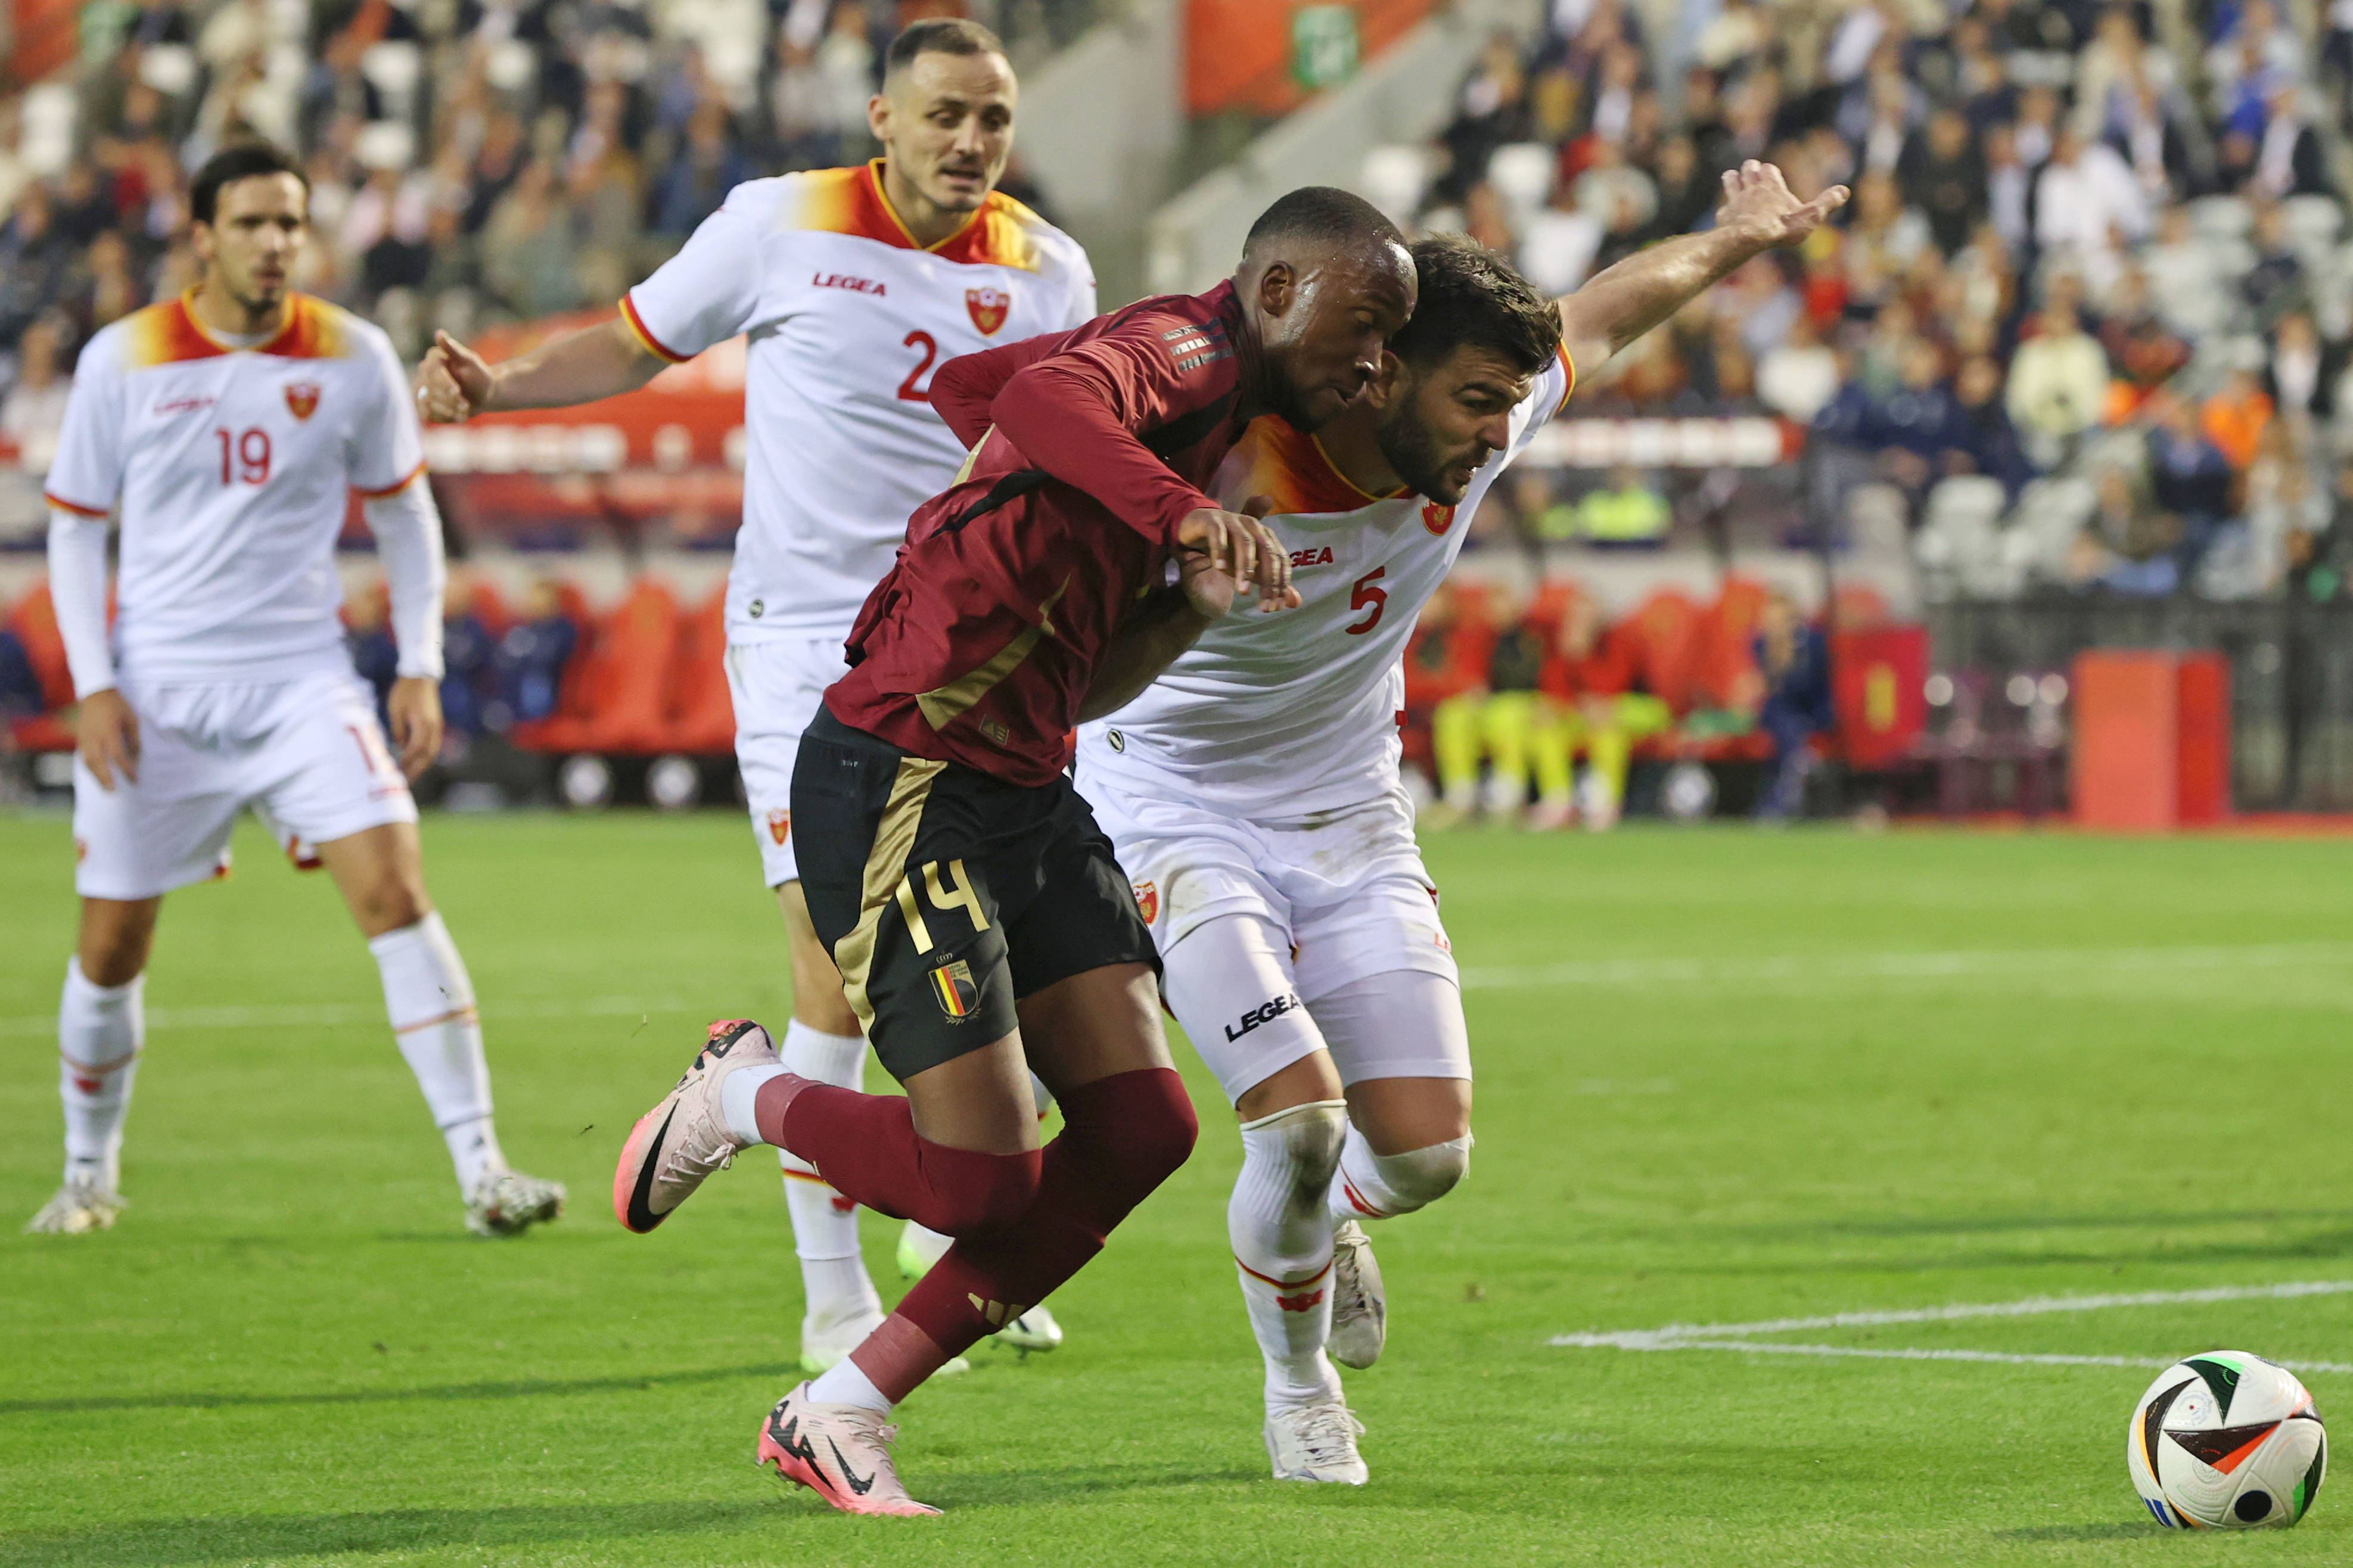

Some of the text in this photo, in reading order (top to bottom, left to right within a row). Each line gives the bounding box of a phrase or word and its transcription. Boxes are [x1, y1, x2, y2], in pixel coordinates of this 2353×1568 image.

[813, 272, 886, 297] LEGEA
[897, 329, 937, 403] 2
[215, 427, 271, 487] 19
[1289, 546, 1334, 568] GEA
[1345, 565, 1388, 636] 5
[896, 858, 991, 956] 14
[1224, 993, 1301, 1043] LEGEA
